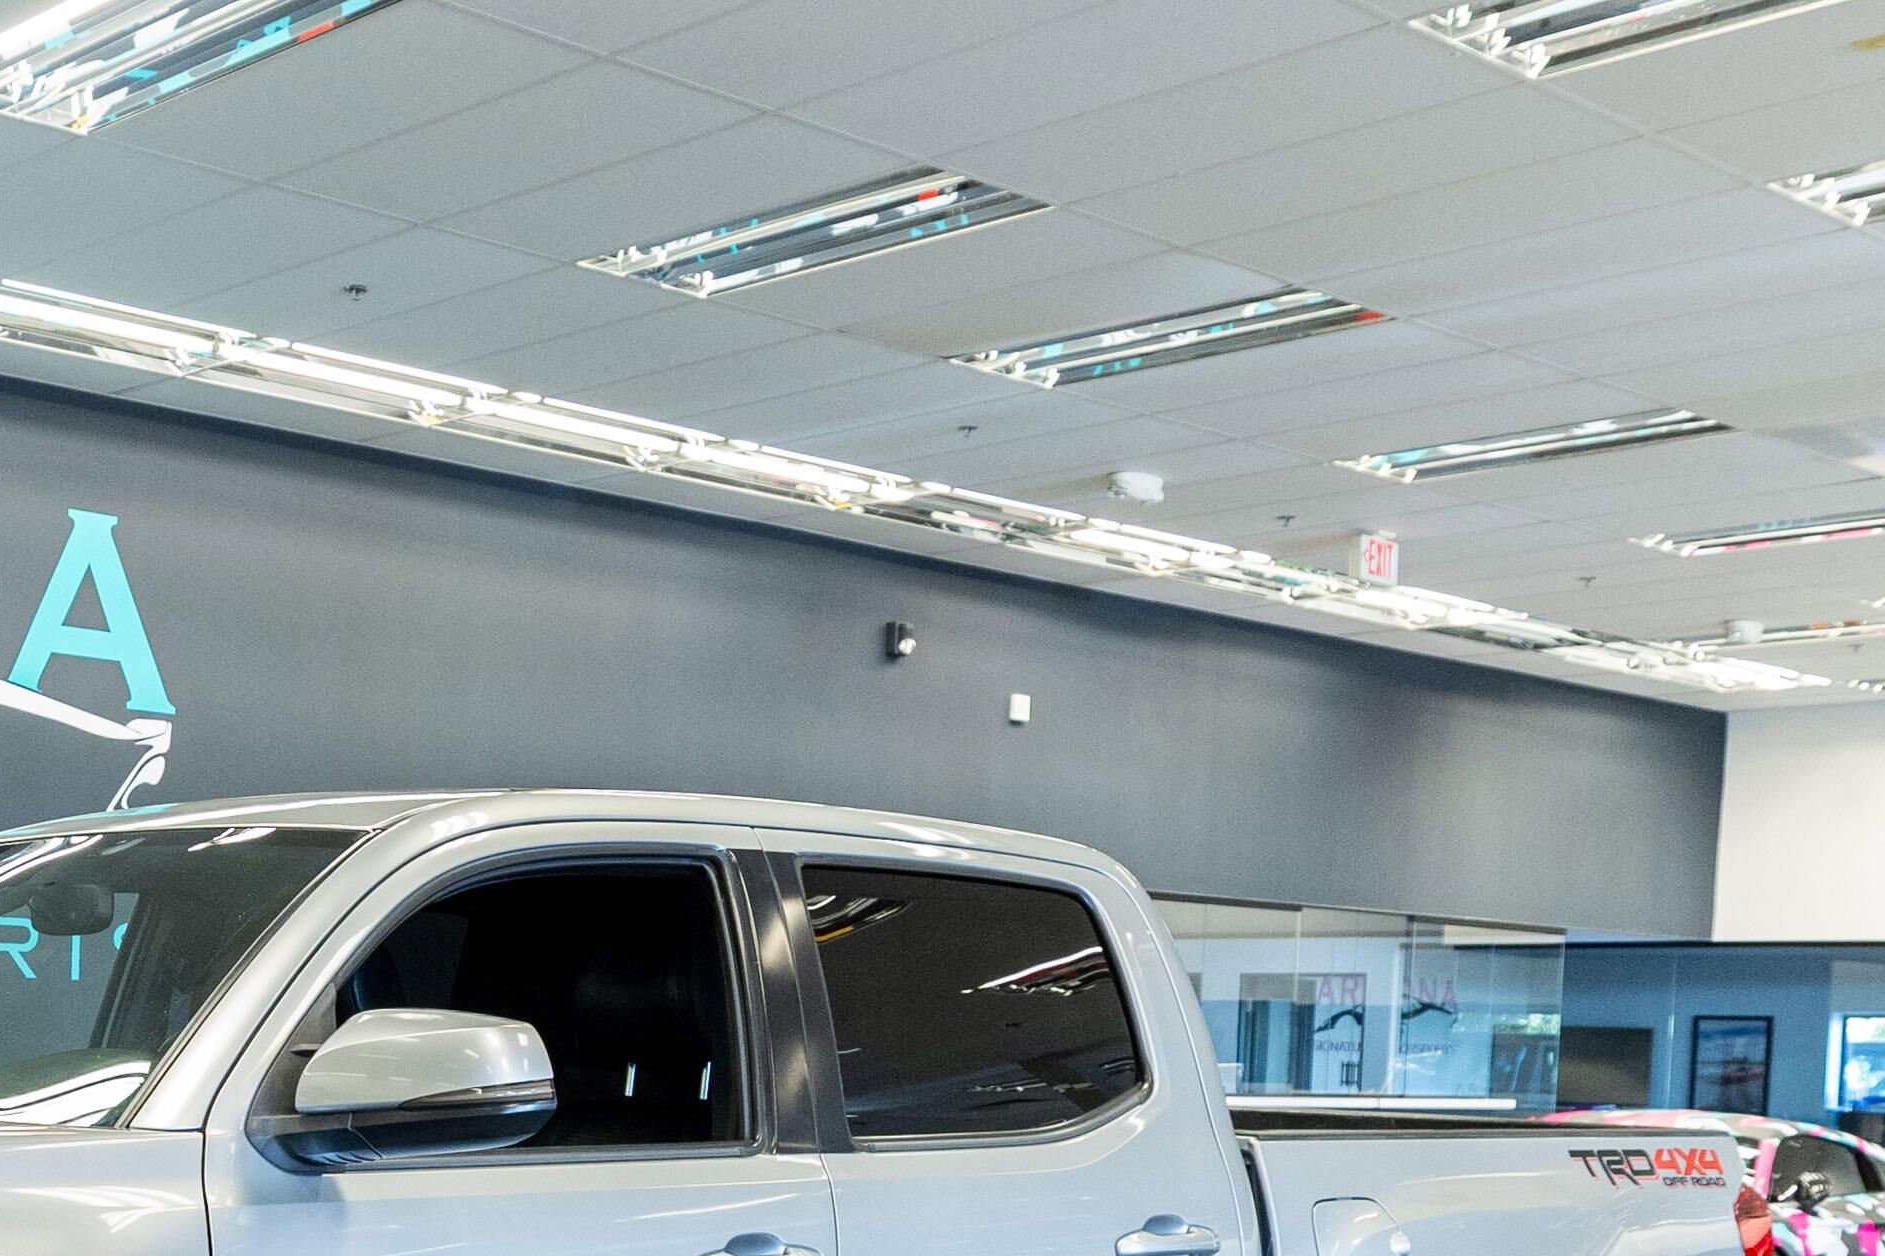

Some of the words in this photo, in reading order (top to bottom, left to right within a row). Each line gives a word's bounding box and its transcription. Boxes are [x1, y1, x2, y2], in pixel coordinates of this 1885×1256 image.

[1368, 539, 1393, 577] EXIT
[1569, 1149, 1659, 1188] TRD
[1662, 1177, 1688, 1187] OFF
[1690, 1177, 1726, 1187] ROAD
